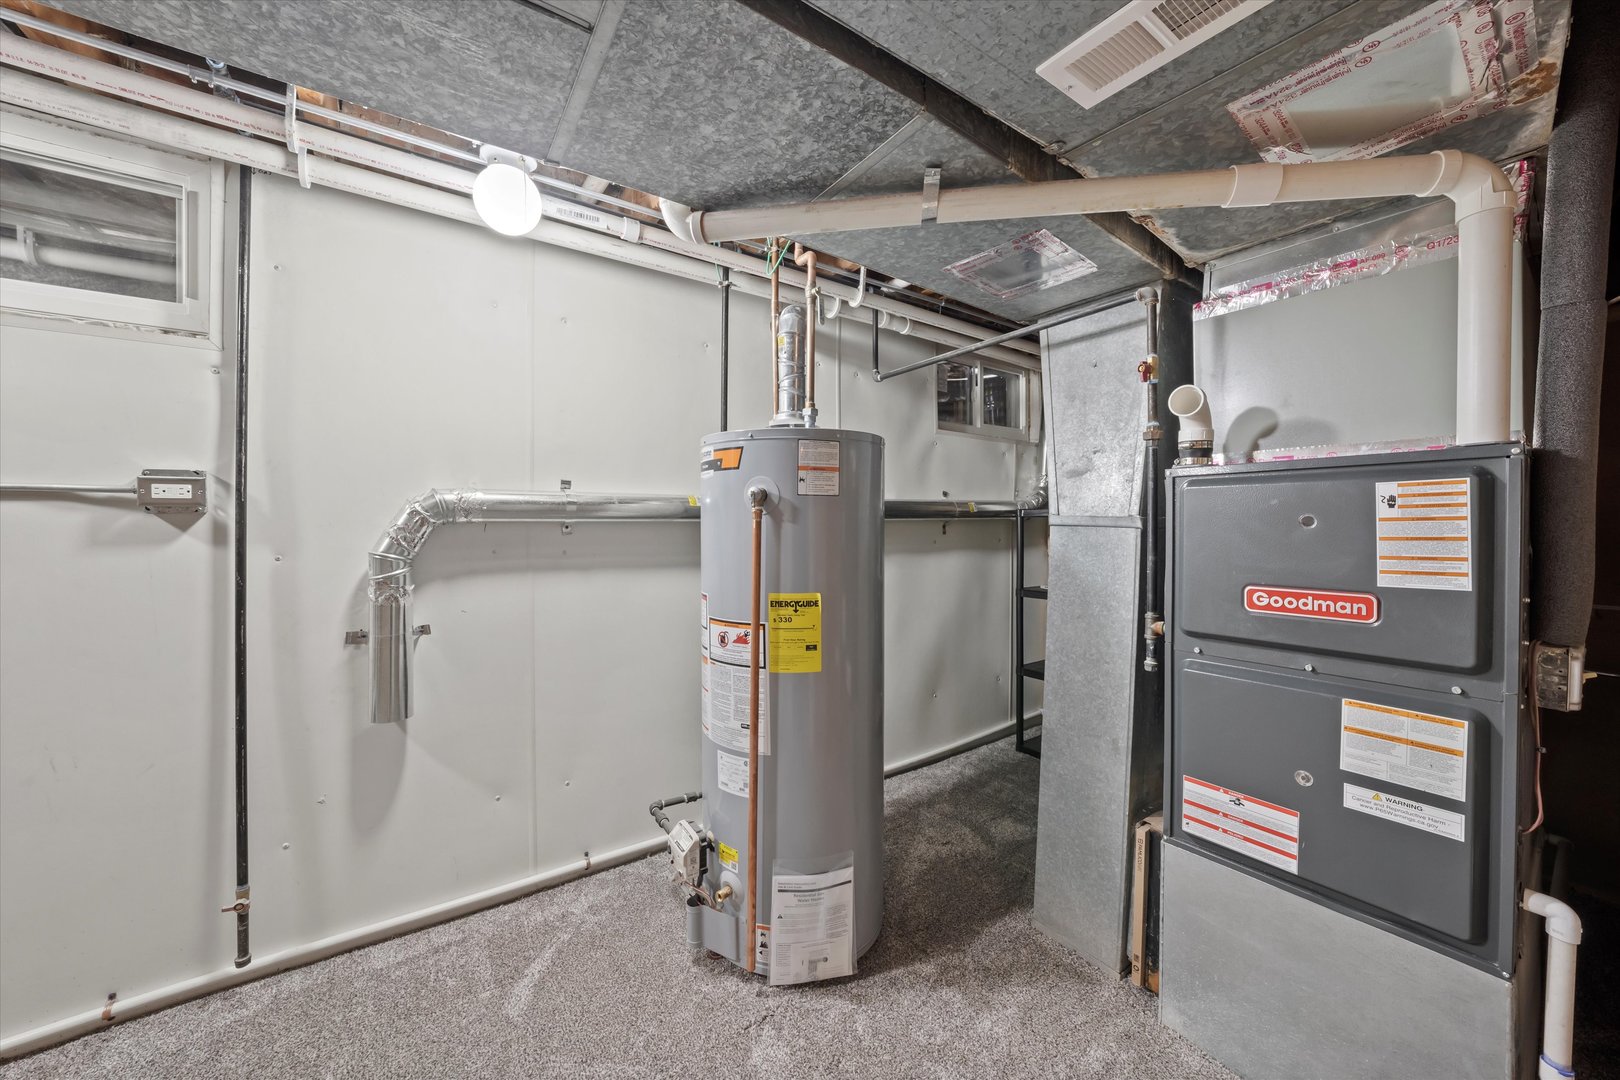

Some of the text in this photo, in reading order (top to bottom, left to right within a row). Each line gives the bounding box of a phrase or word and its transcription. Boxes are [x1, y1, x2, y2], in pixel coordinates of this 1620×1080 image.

[770, 600, 819, 609] ENERGYGUIDE
[1252, 591, 1367, 616] Goodman
[1351, 795, 1372, 806] Cancer
[1373, 800, 1385, 809] and
[1386, 804, 1427, 820] Reproductive
[1427, 816, 1446, 826] Harm
[1360, 803, 1439, 829] www.P65Warnings.ca.gov
[1384, 796, 1423, 812] WARNING
